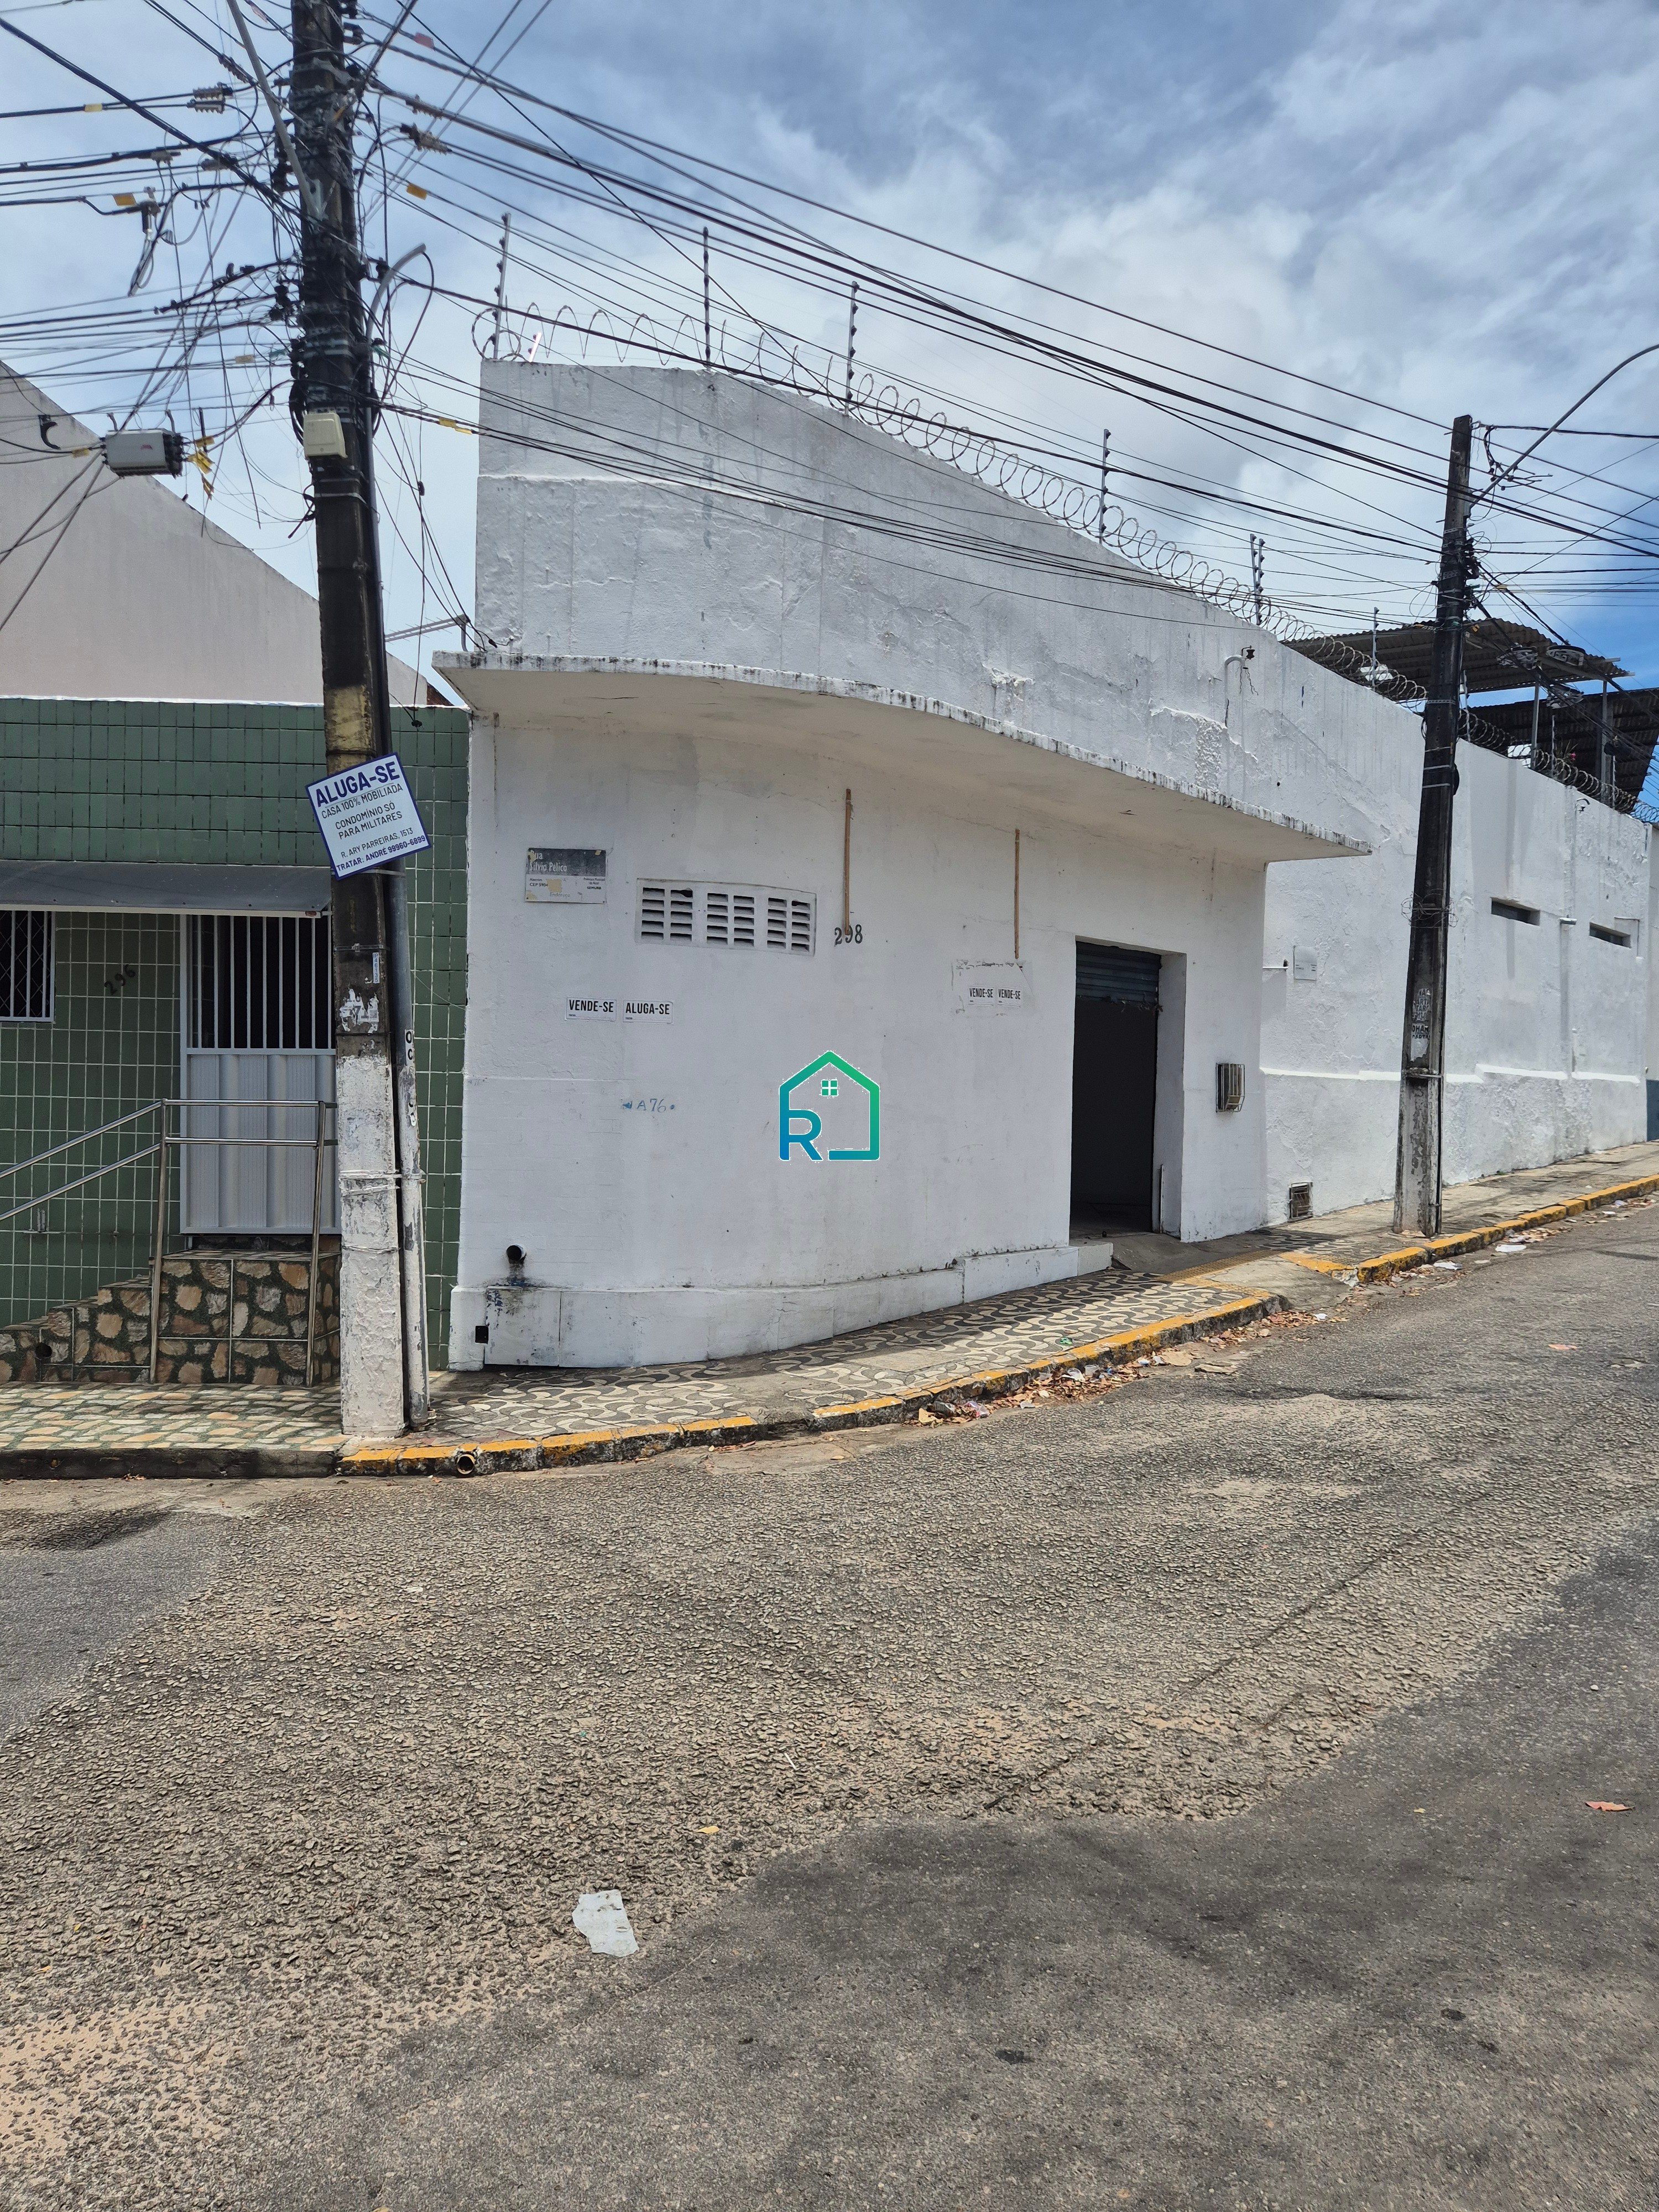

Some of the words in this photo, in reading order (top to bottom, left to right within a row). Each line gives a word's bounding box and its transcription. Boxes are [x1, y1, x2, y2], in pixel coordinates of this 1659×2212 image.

[316, 762, 400, 807] ALUGA-SE
[321, 806, 341, 819] CASA
[341, 798, 361, 811] 100%
[361, 783, 403, 804] MOBILIADA
[335, 806, 383, 830] CONDOMÍNIO
[384, 800, 395, 811] SÓ
[338, 827, 361, 840] PARA
[361, 811, 403, 831] MILITARES
[337, 857, 364, 871] TRATAR:
[366, 846, 388, 861] ANDRÉ
[388, 835, 426, 853] 99960-6899
[349, 845, 361, 856] ARY
[362, 833, 400, 851] PARREIRAS,
[400, 827, 413, 837] 1513
[834, 924, 863, 947] 298
[104, 964, 137, 995] 296
[969, 988, 993, 998] VENDE-SE
[998, 988, 1021, 1000] VENDE-SE
[569, 1000, 614, 1012] VENDE-SE
[625, 1002, 670, 1014] ALUGA-SE
